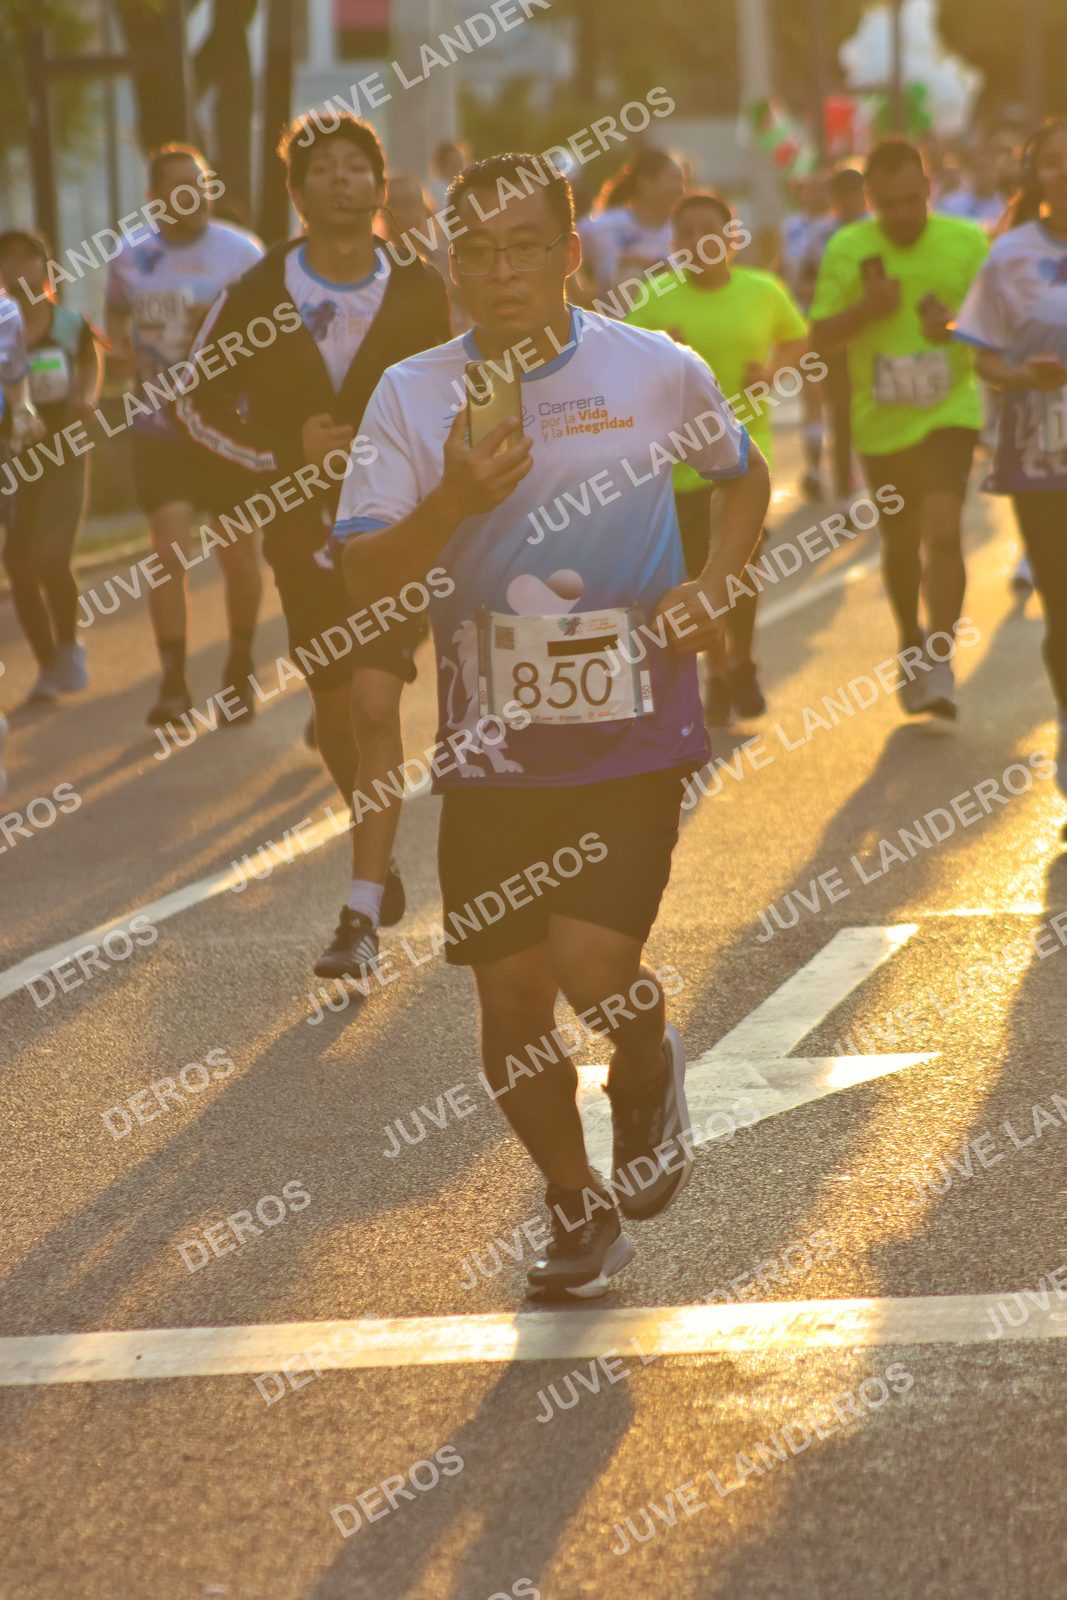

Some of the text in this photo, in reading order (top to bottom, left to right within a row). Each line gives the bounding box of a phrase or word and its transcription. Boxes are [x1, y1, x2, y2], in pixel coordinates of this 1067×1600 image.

[538, 395, 605, 416] Carrera
[541, 408, 609, 431] por la Vida
[541, 416, 634, 442] y la Integridad
[512, 658, 613, 709] 850
